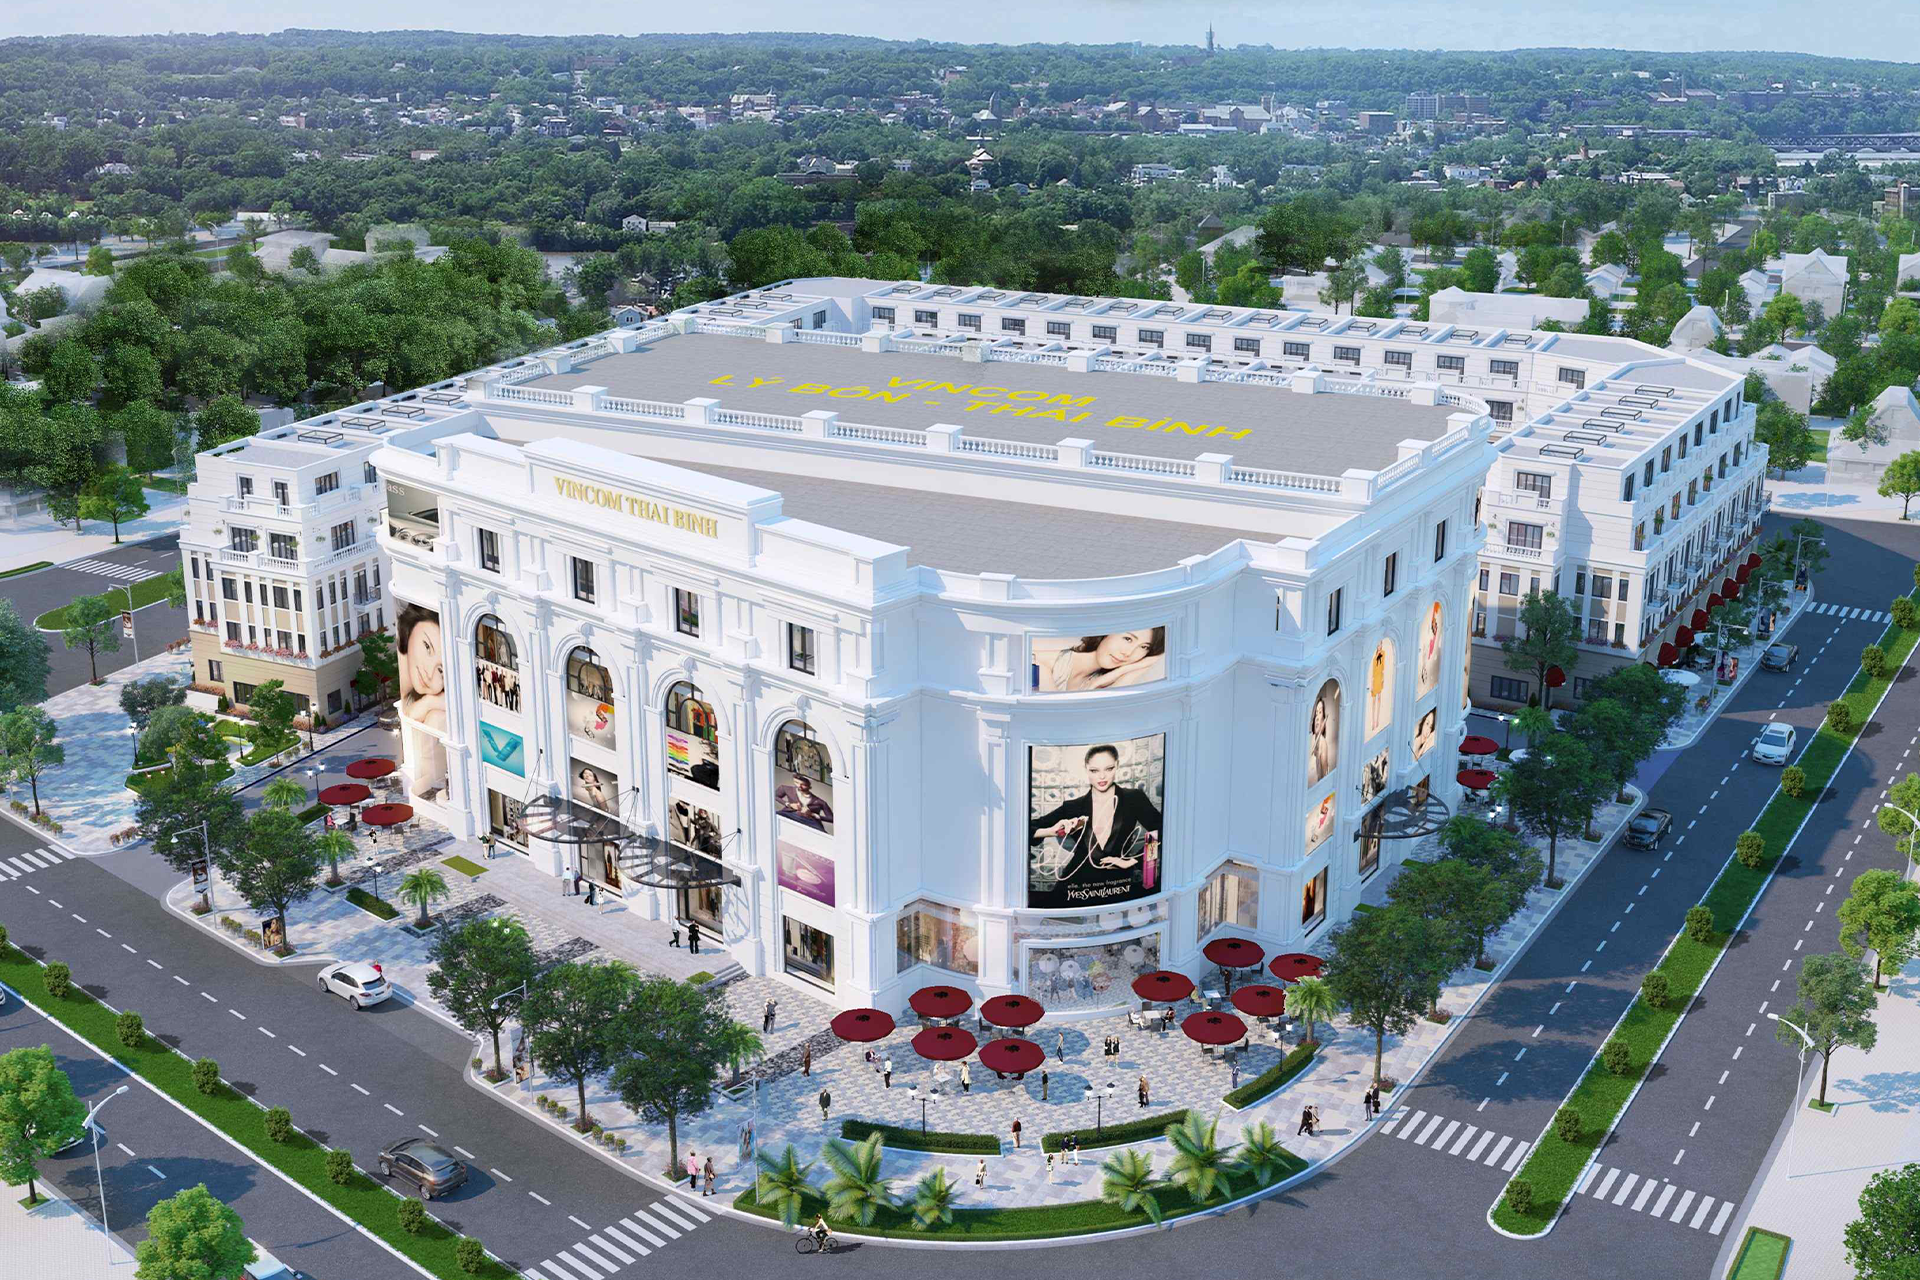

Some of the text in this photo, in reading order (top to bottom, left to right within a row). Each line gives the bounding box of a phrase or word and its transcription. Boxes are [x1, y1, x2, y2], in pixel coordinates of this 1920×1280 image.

[888, 376, 1098, 407] VINCOM
[553, 475, 719, 539] VINCOM THAI BINH
